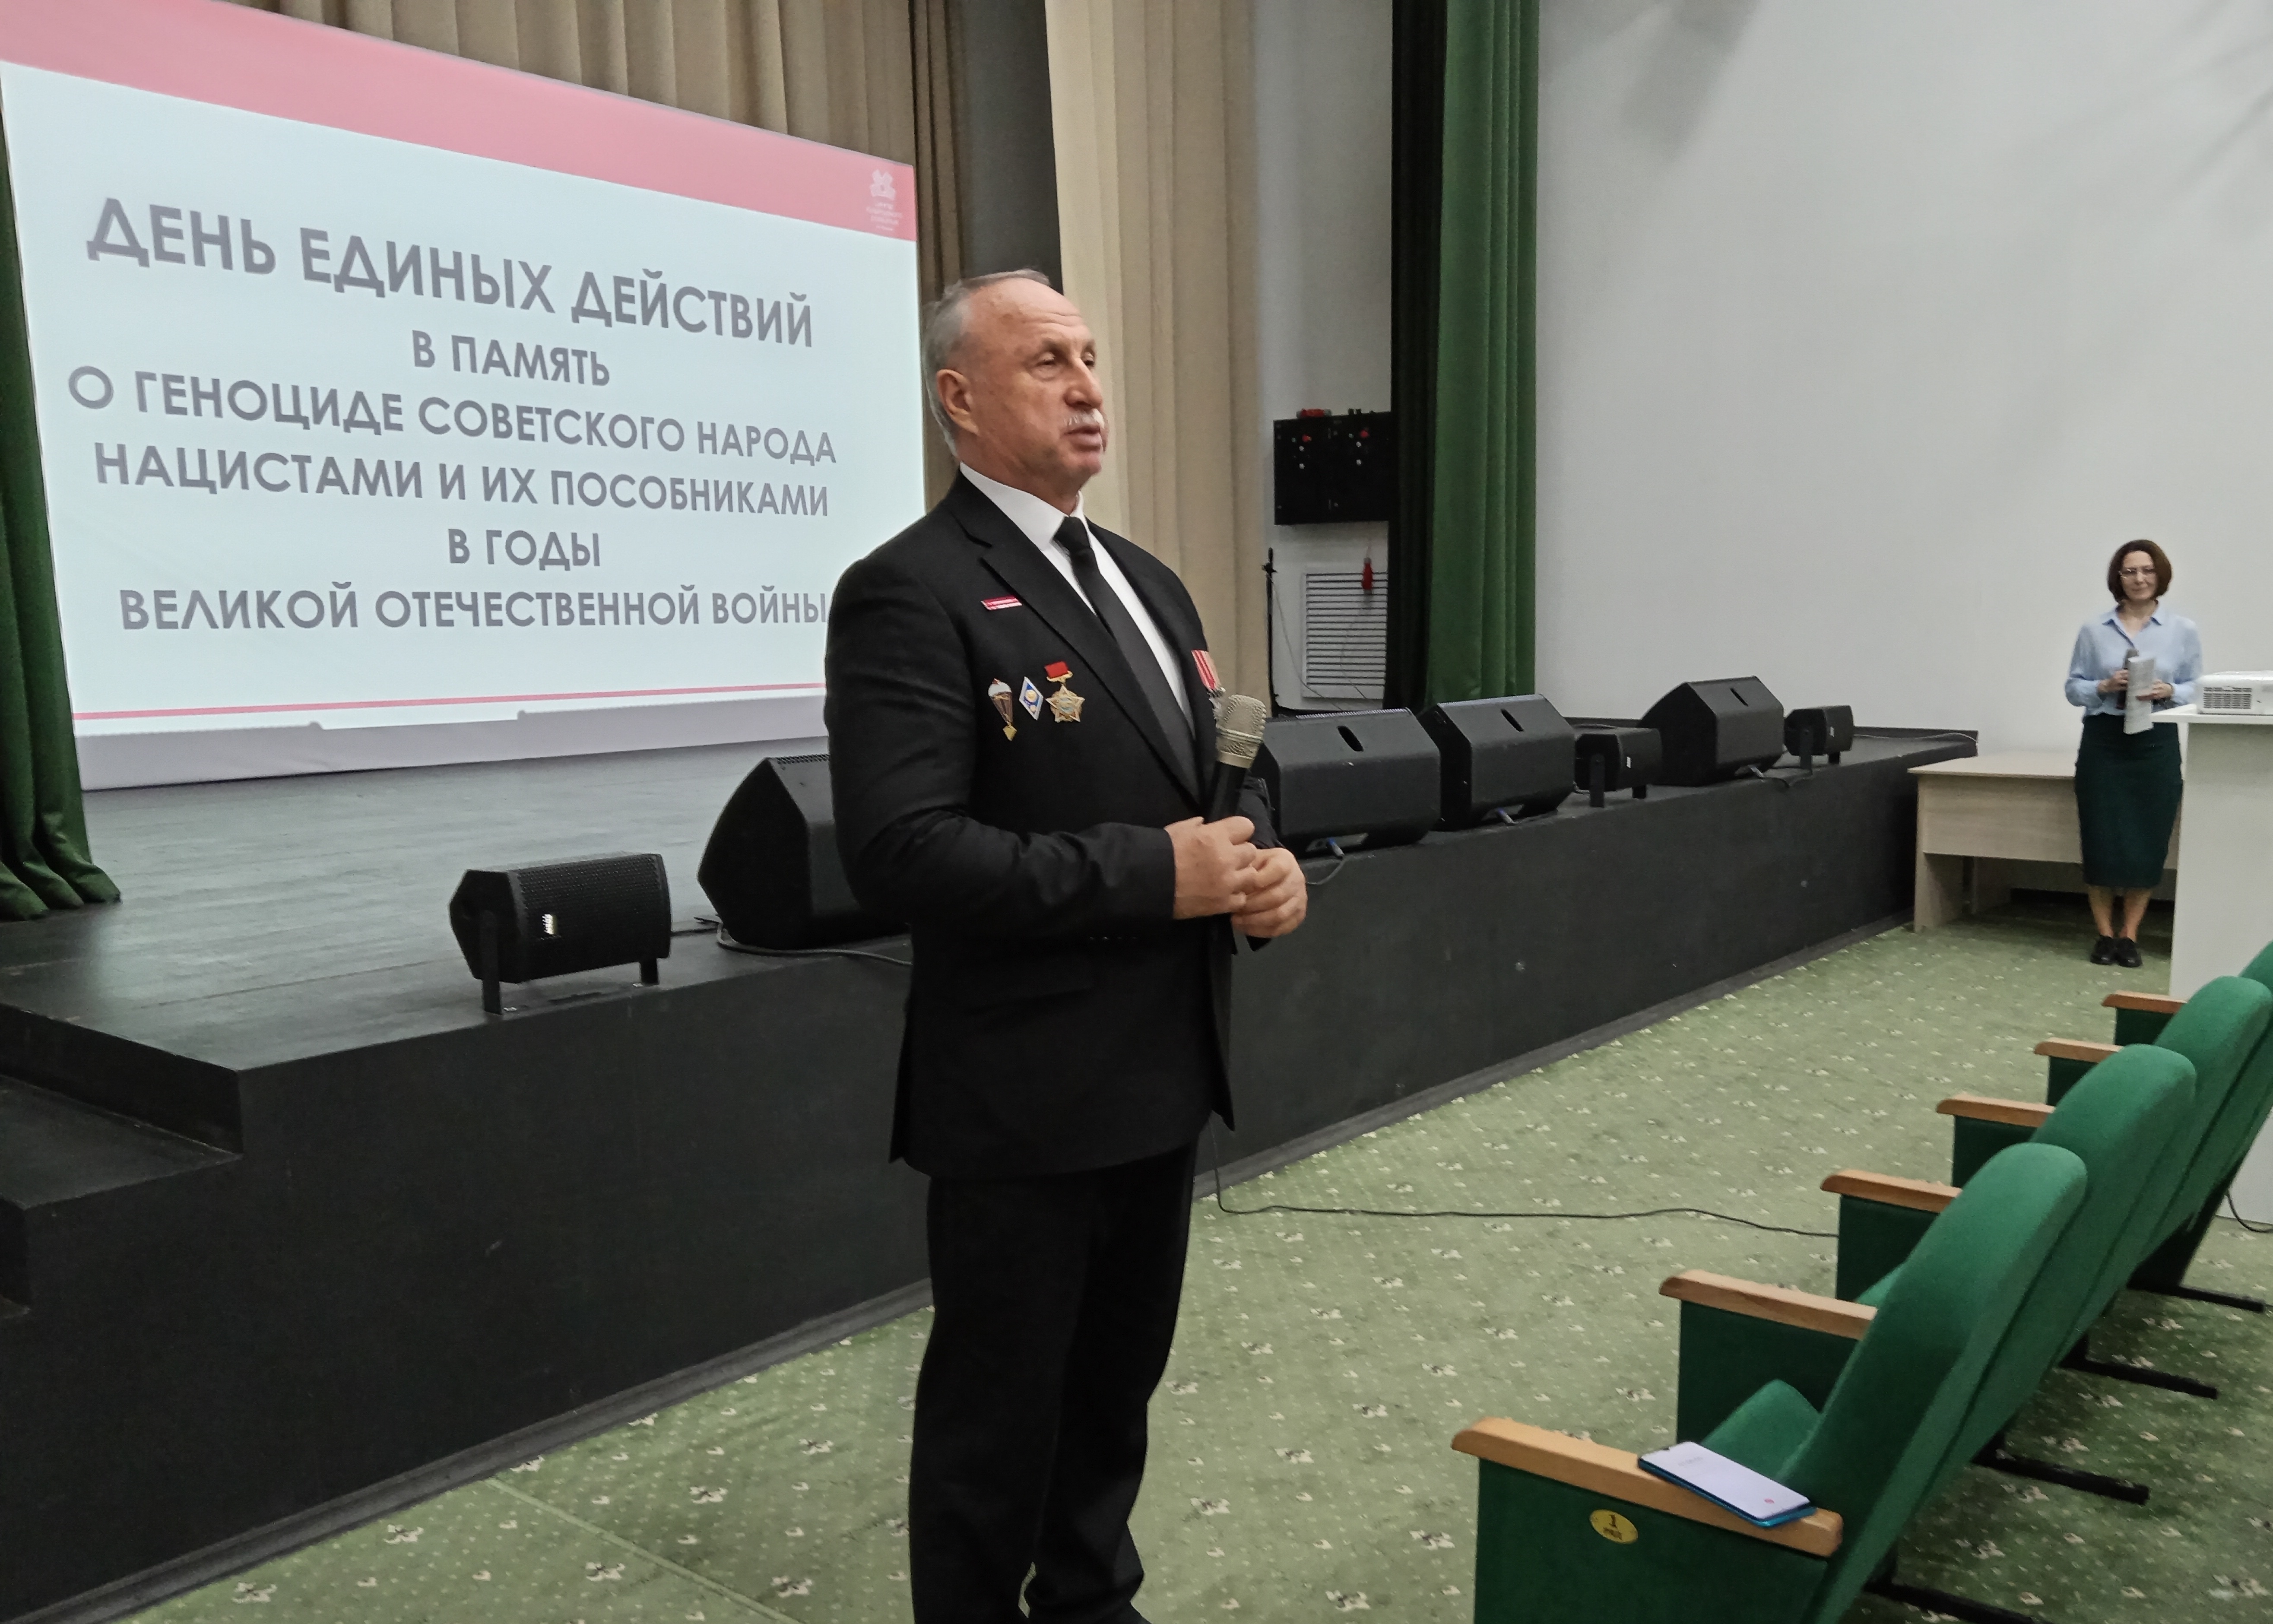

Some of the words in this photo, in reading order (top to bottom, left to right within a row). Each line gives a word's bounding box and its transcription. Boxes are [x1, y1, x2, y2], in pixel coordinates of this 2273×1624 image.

[86, 197, 276, 275] ДЕНЬ
[300, 227, 556, 314] ЕДИНЫХ
[571, 268, 812, 348] ДЕЙСТВИЙ
[412, 330, 435, 368] В
[451, 335, 610, 386] ПАМЯТЬ
[68, 365, 114, 409] О
[135, 371, 404, 436] ГЕНОЦИДЕ
[418, 396, 685, 452] СОВЕТСКОГО
[697, 421, 837, 466] НАРОДА
[94, 442, 423, 498] НАЦИСТАМИ
[439, 463, 466, 500] И
[482, 466, 538, 504] ИХ
[551, 470, 829, 517] ПОСОБНИКАМИ
[448, 528, 470, 564] В
[485, 529, 602, 571] ГОДЫ
[120, 581, 358, 630] ВЕЛИКОЙ
[375, 584, 699, 628] ОТЕЧЕСТВЕННОЙ
[712, 585, 826, 624] ВОЙНЫ
[1609, 1514, 1618, 1529] 1
